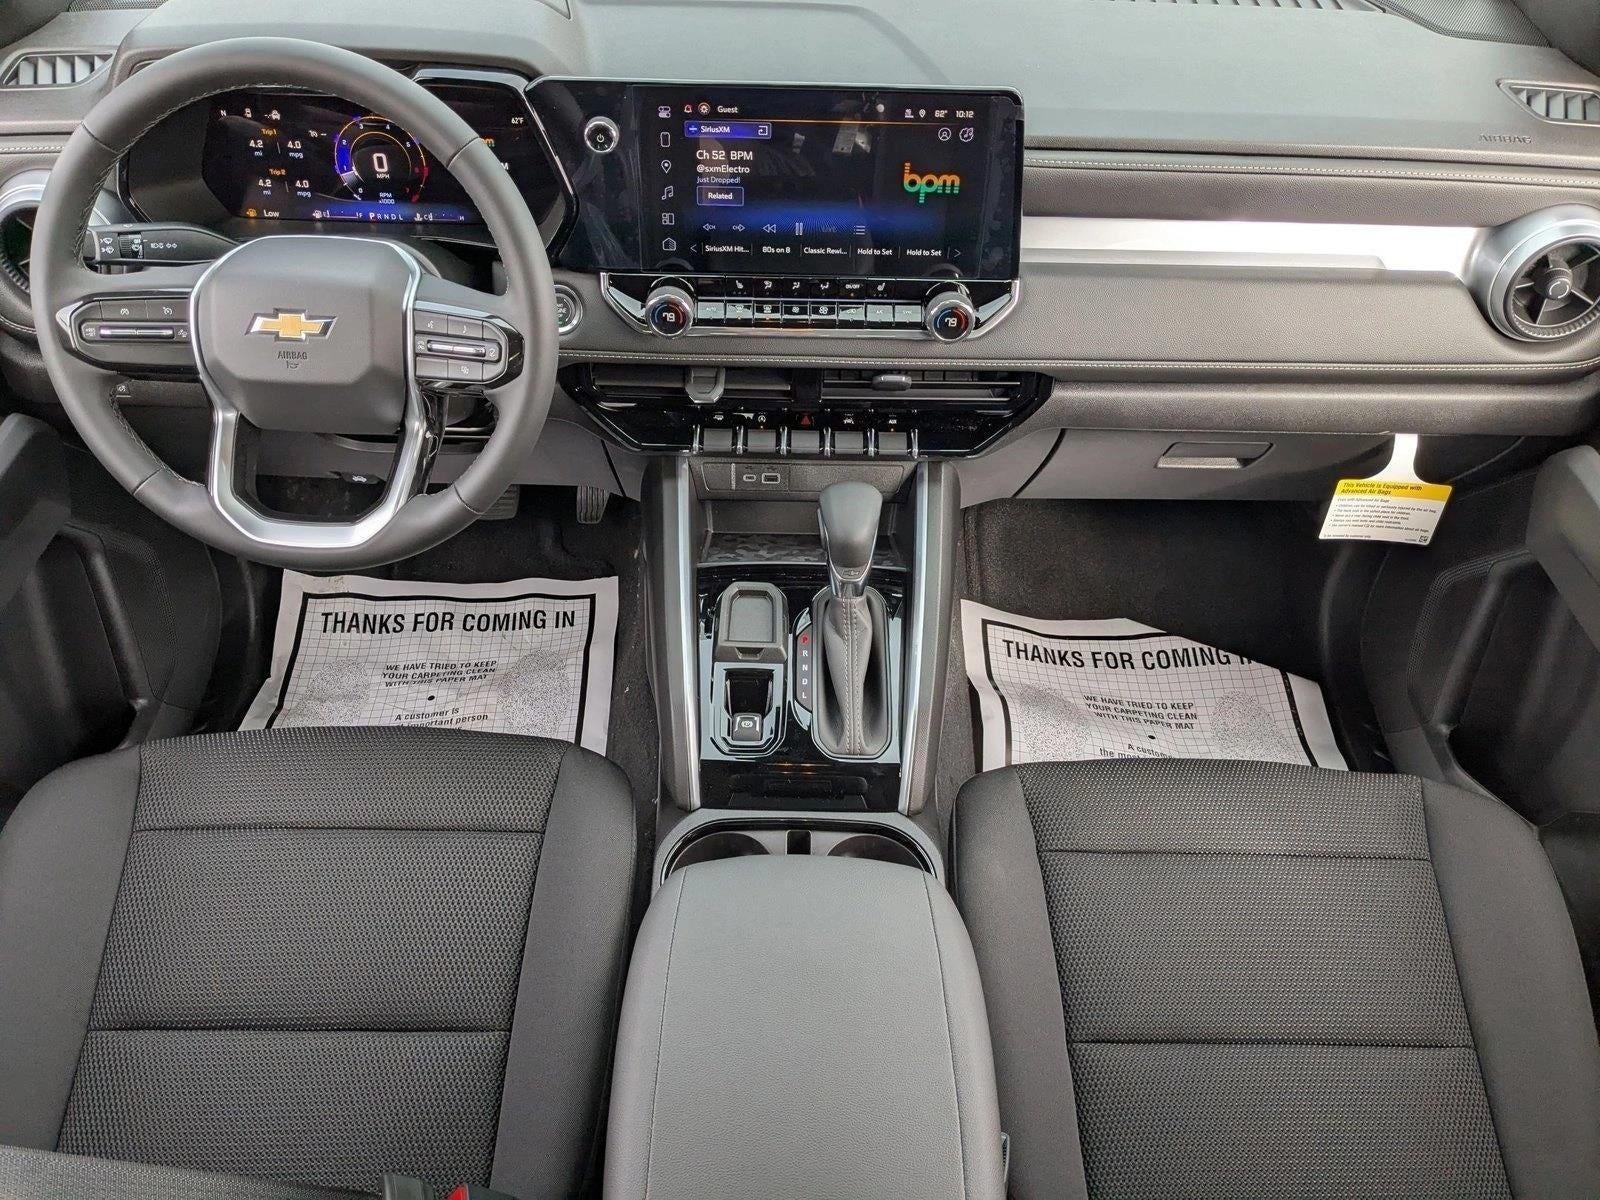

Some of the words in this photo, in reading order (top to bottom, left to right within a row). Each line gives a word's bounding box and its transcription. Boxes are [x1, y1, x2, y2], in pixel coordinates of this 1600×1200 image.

[696, 150, 709, 160] Ch
[712, 151, 725, 160] 52
[730, 151, 753, 160] BPM
[373, 153, 388, 172] 0
[696, 165, 750, 173] @sxmElectro
[904, 162, 960, 203] bpm
[662, 312, 675, 322] 79
[944, 318, 957, 327] 79
[278, 351, 308, 360] AIRBAG
[321, 612, 405, 634] THANKS
[412, 611, 454, 632] FOR
[462, 609, 547, 632] COMING
[555, 610, 575, 628] IN
[1002, 639, 1085, 668] THANKS
[1091, 651, 1135, 670] FOR
[1141, 647, 1231, 670] COMING
[403, 663, 426, 671] HAVE
[411, 670, 463, 679] CARPETING
[1100, 697, 1124, 706] HAVE
[1126, 701, 1153, 709] TRIED
[404, 710, 449, 720] customer
[1086, 703, 1111, 712] YOUR
[1114, 707, 1164, 719] CARPETING
[455, 714, 488, 724] person
[1094, 712, 1118, 720] WITH
[1143, 719, 1172, 728] PAPER
[1100, 748, 1114, 757] the
